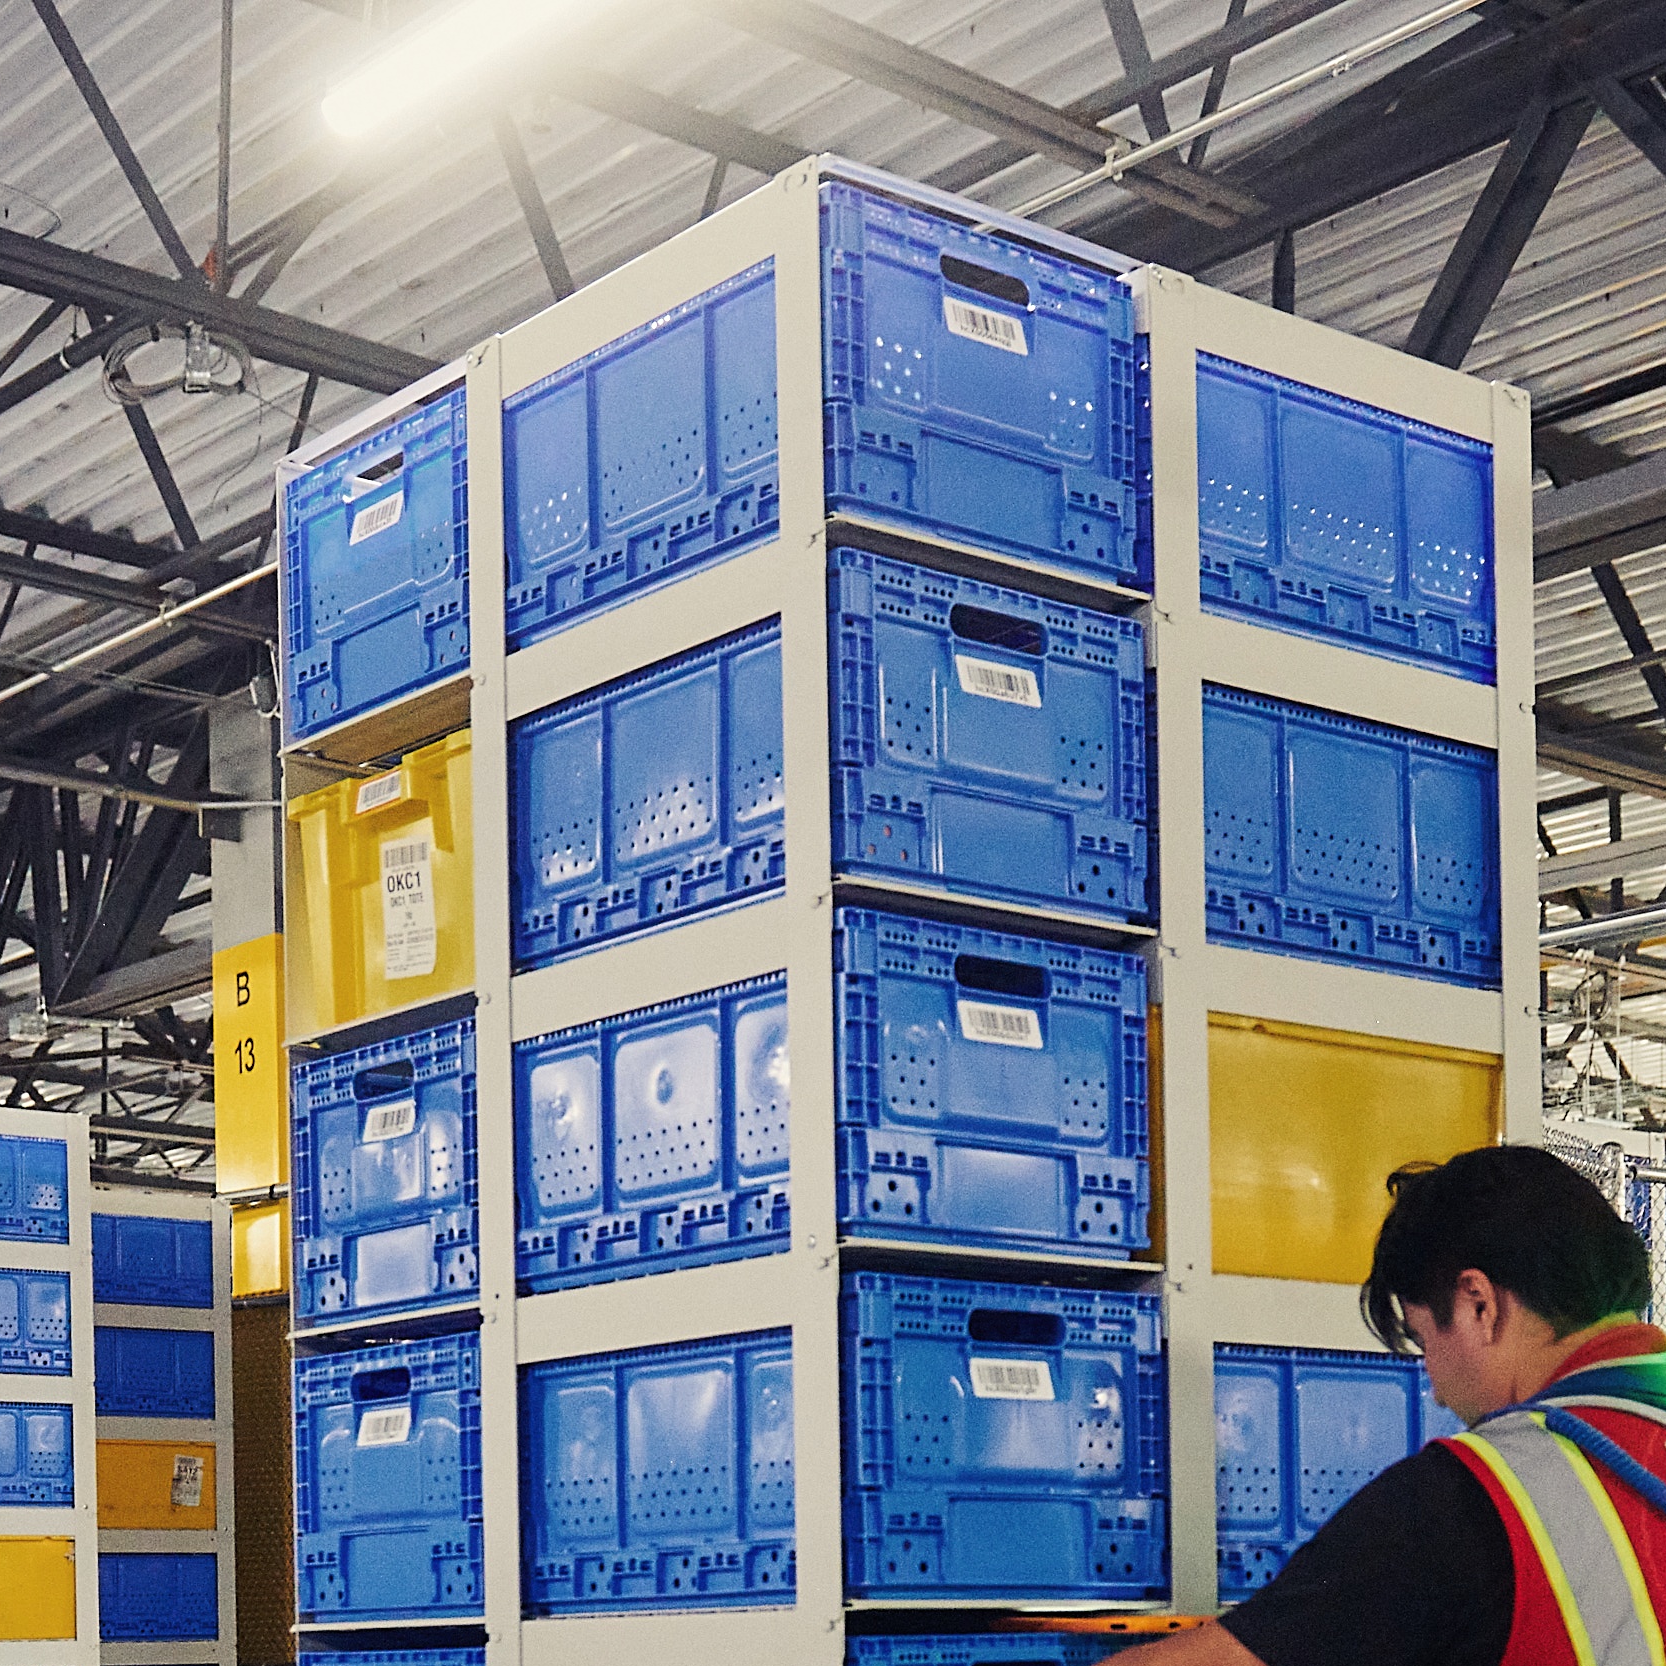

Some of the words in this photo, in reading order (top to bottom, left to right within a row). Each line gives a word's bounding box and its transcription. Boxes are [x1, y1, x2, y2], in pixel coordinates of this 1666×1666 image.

[387, 871, 422, 893] OKC1
[236, 971, 251, 1007] B
[234, 1038, 255, 1074] 13
